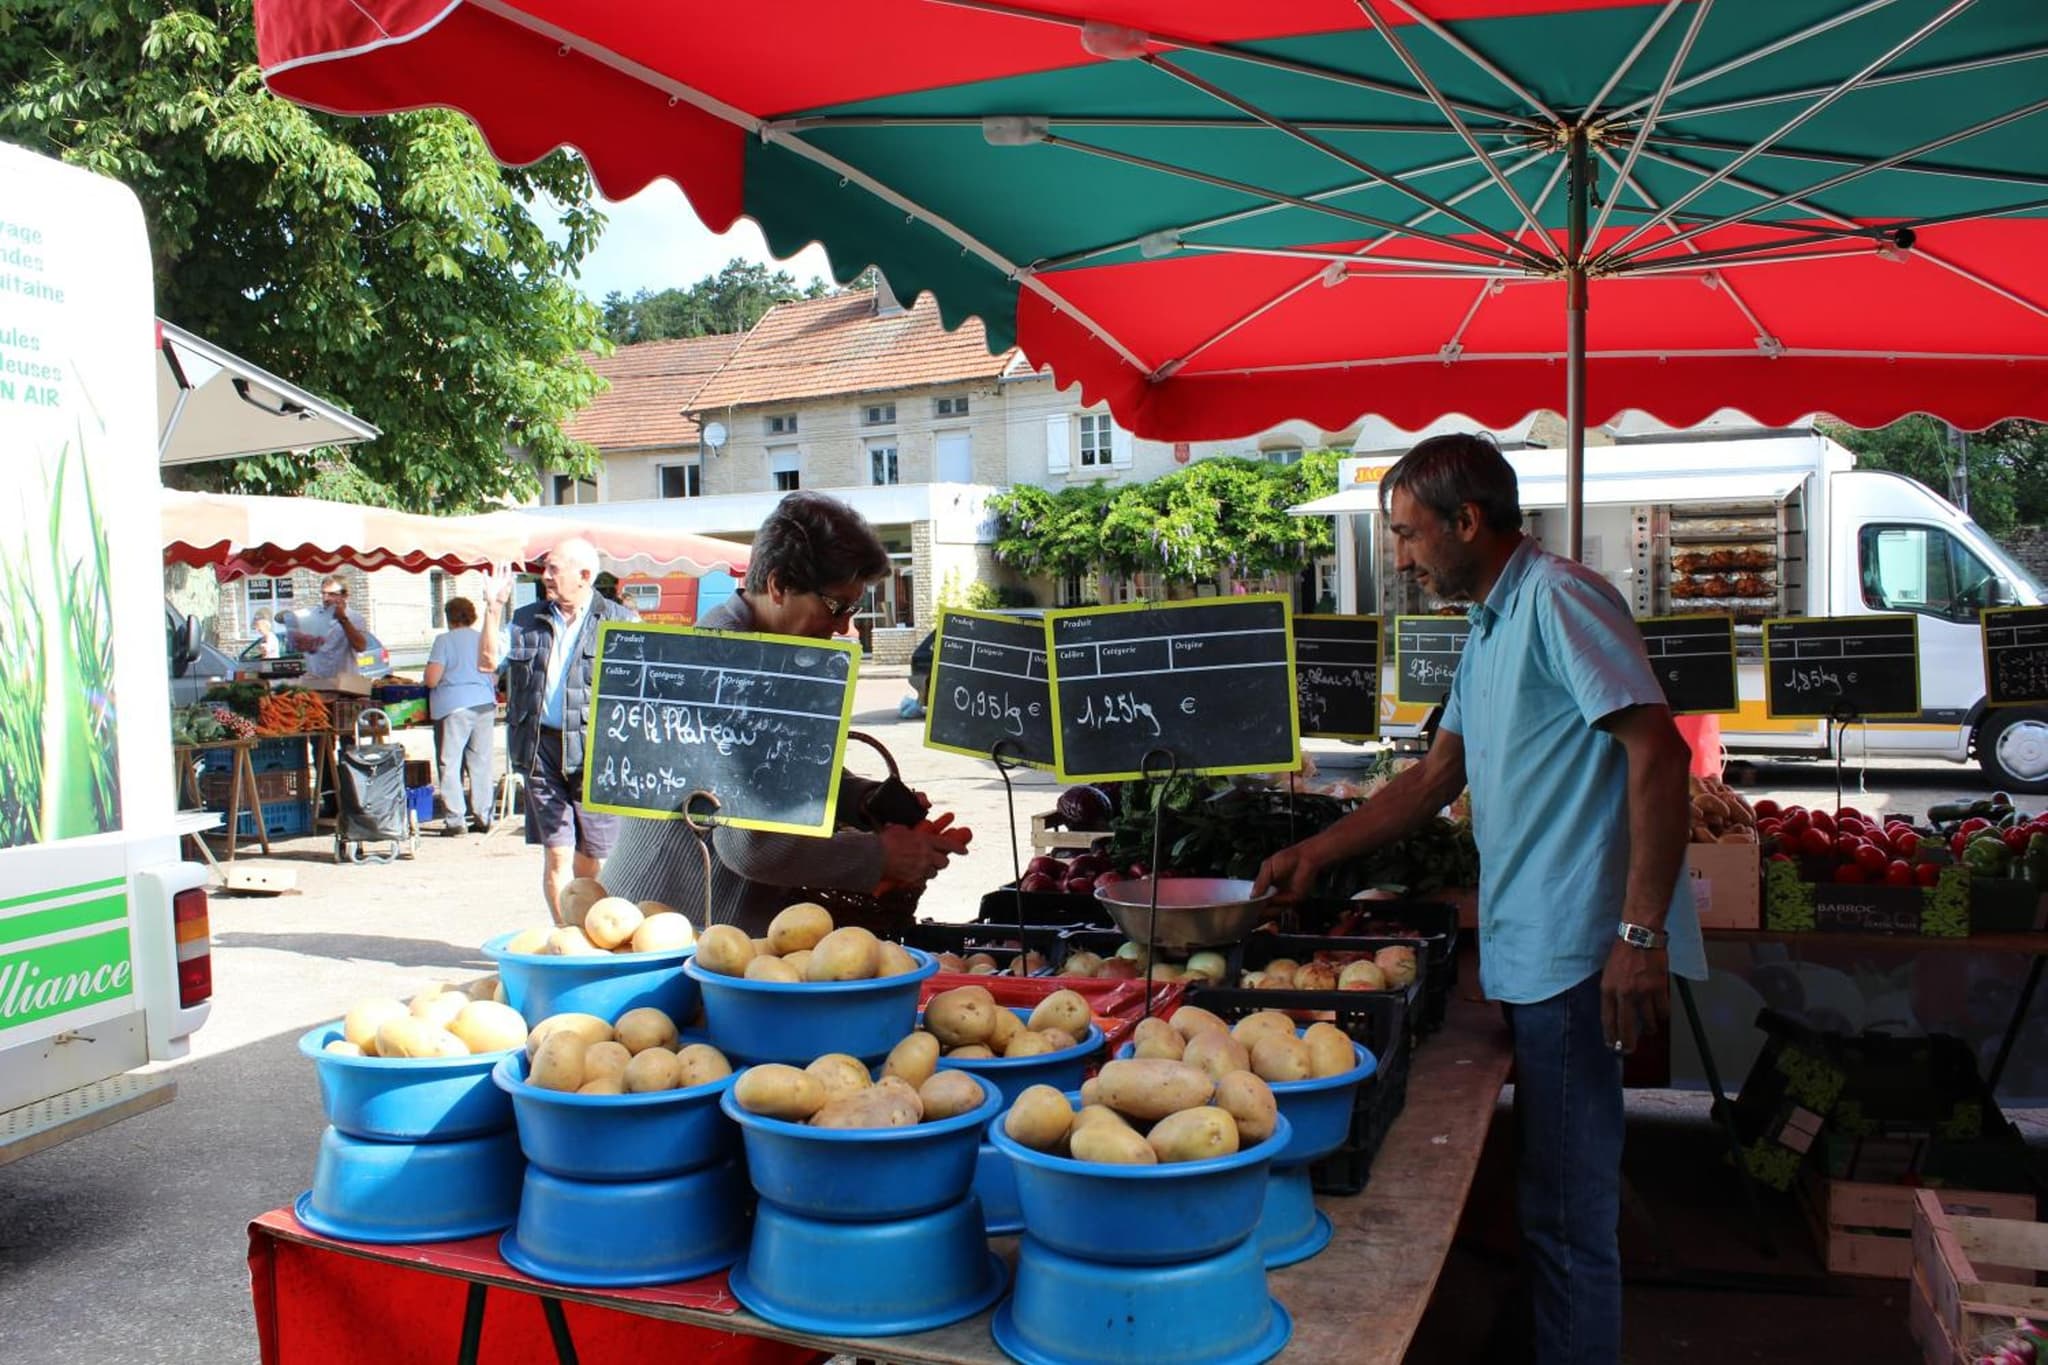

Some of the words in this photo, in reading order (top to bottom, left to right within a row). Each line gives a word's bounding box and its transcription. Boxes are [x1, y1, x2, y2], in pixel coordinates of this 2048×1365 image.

[24, 384, 61, 407] AIR
[1063, 619, 1092, 629] Produit
[615, 633, 646, 643] Produit
[1174, 640, 1204, 651] Origine
[605, 666, 632, 676] Calibre
[1668, 670, 1680, 682] €
[1847, 672, 1858, 684] €
[1028, 702, 1041, 716] €
[1180, 696, 1196, 714] €
